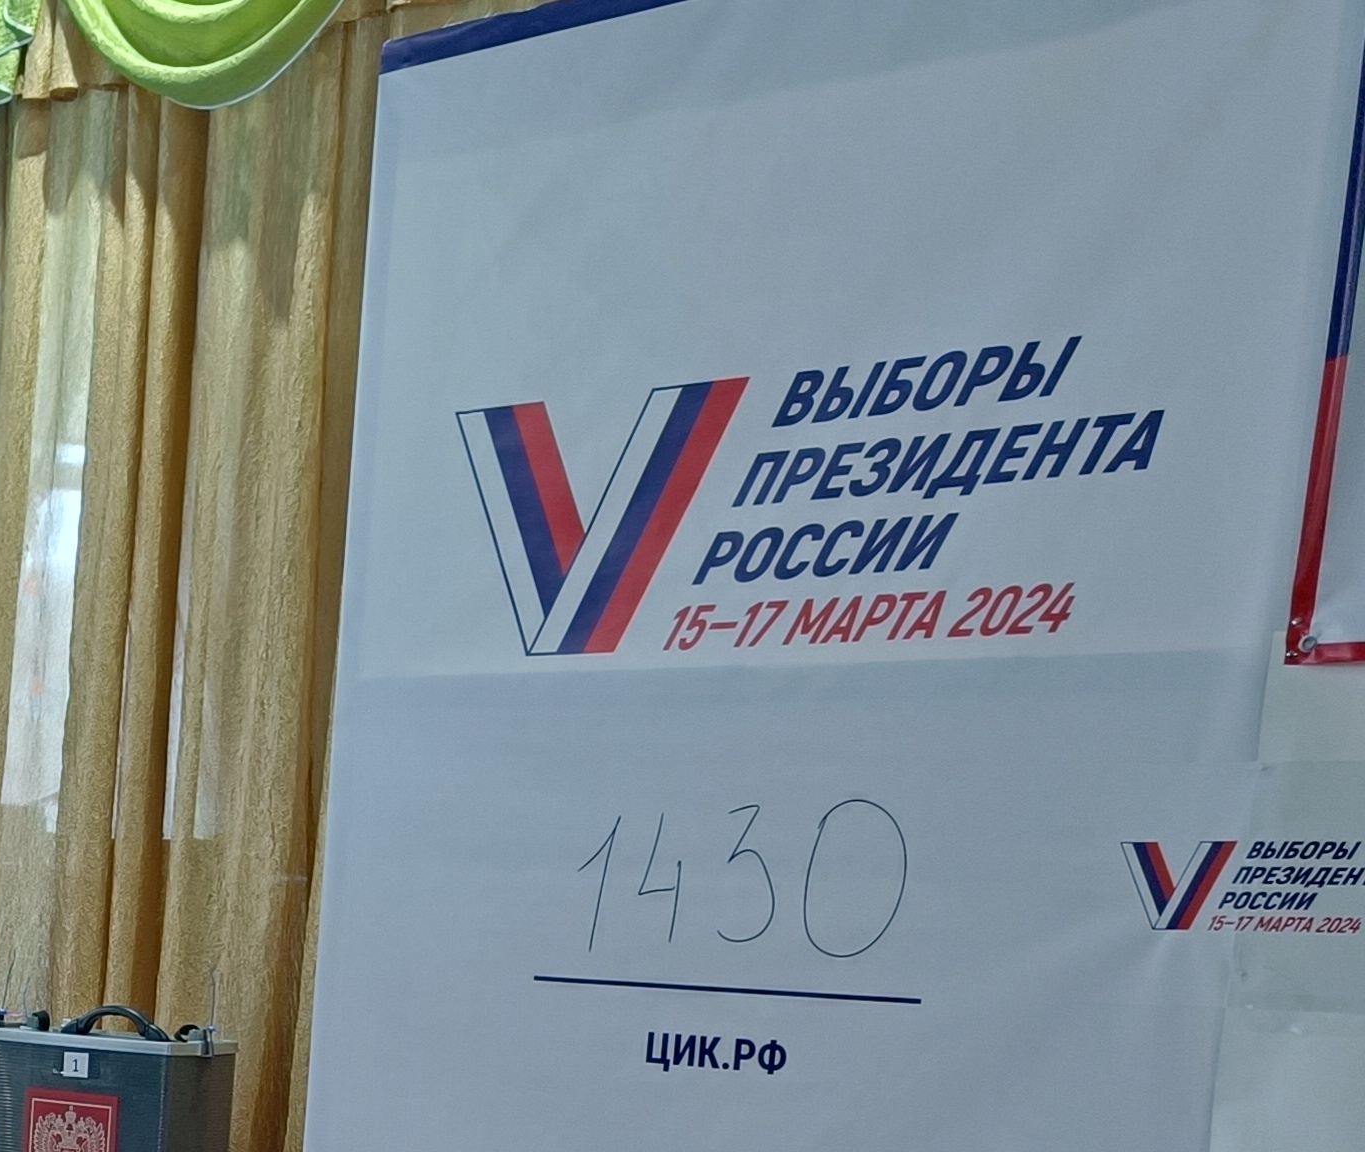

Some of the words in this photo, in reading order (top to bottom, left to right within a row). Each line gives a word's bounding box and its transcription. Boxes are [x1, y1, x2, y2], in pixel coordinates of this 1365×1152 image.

[772, 336, 1081, 428] ВЫБОРЫ
[732, 410, 1165, 507] ПРЕЗИДЕНТА
[692, 513, 959, 586] РОССИИ
[662, 600, 785, 651] 15–17
[783, 590, 945, 646] МАРТА
[947, 582, 1076, 639] 2024
[577, 799, 908, 958] 1430
[1231, 866, 1365, 888] ПРЕЗИДЕН
[1245, 841, 1362, 860] ВЫБОРЫ
[1218, 891, 1318, 911] РОССИИ
[1252, 915, 1315, 933] МАРТА
[1315, 917, 1362, 934] 2024
[645, 1032, 788, 1075] ЦИК.РФ
